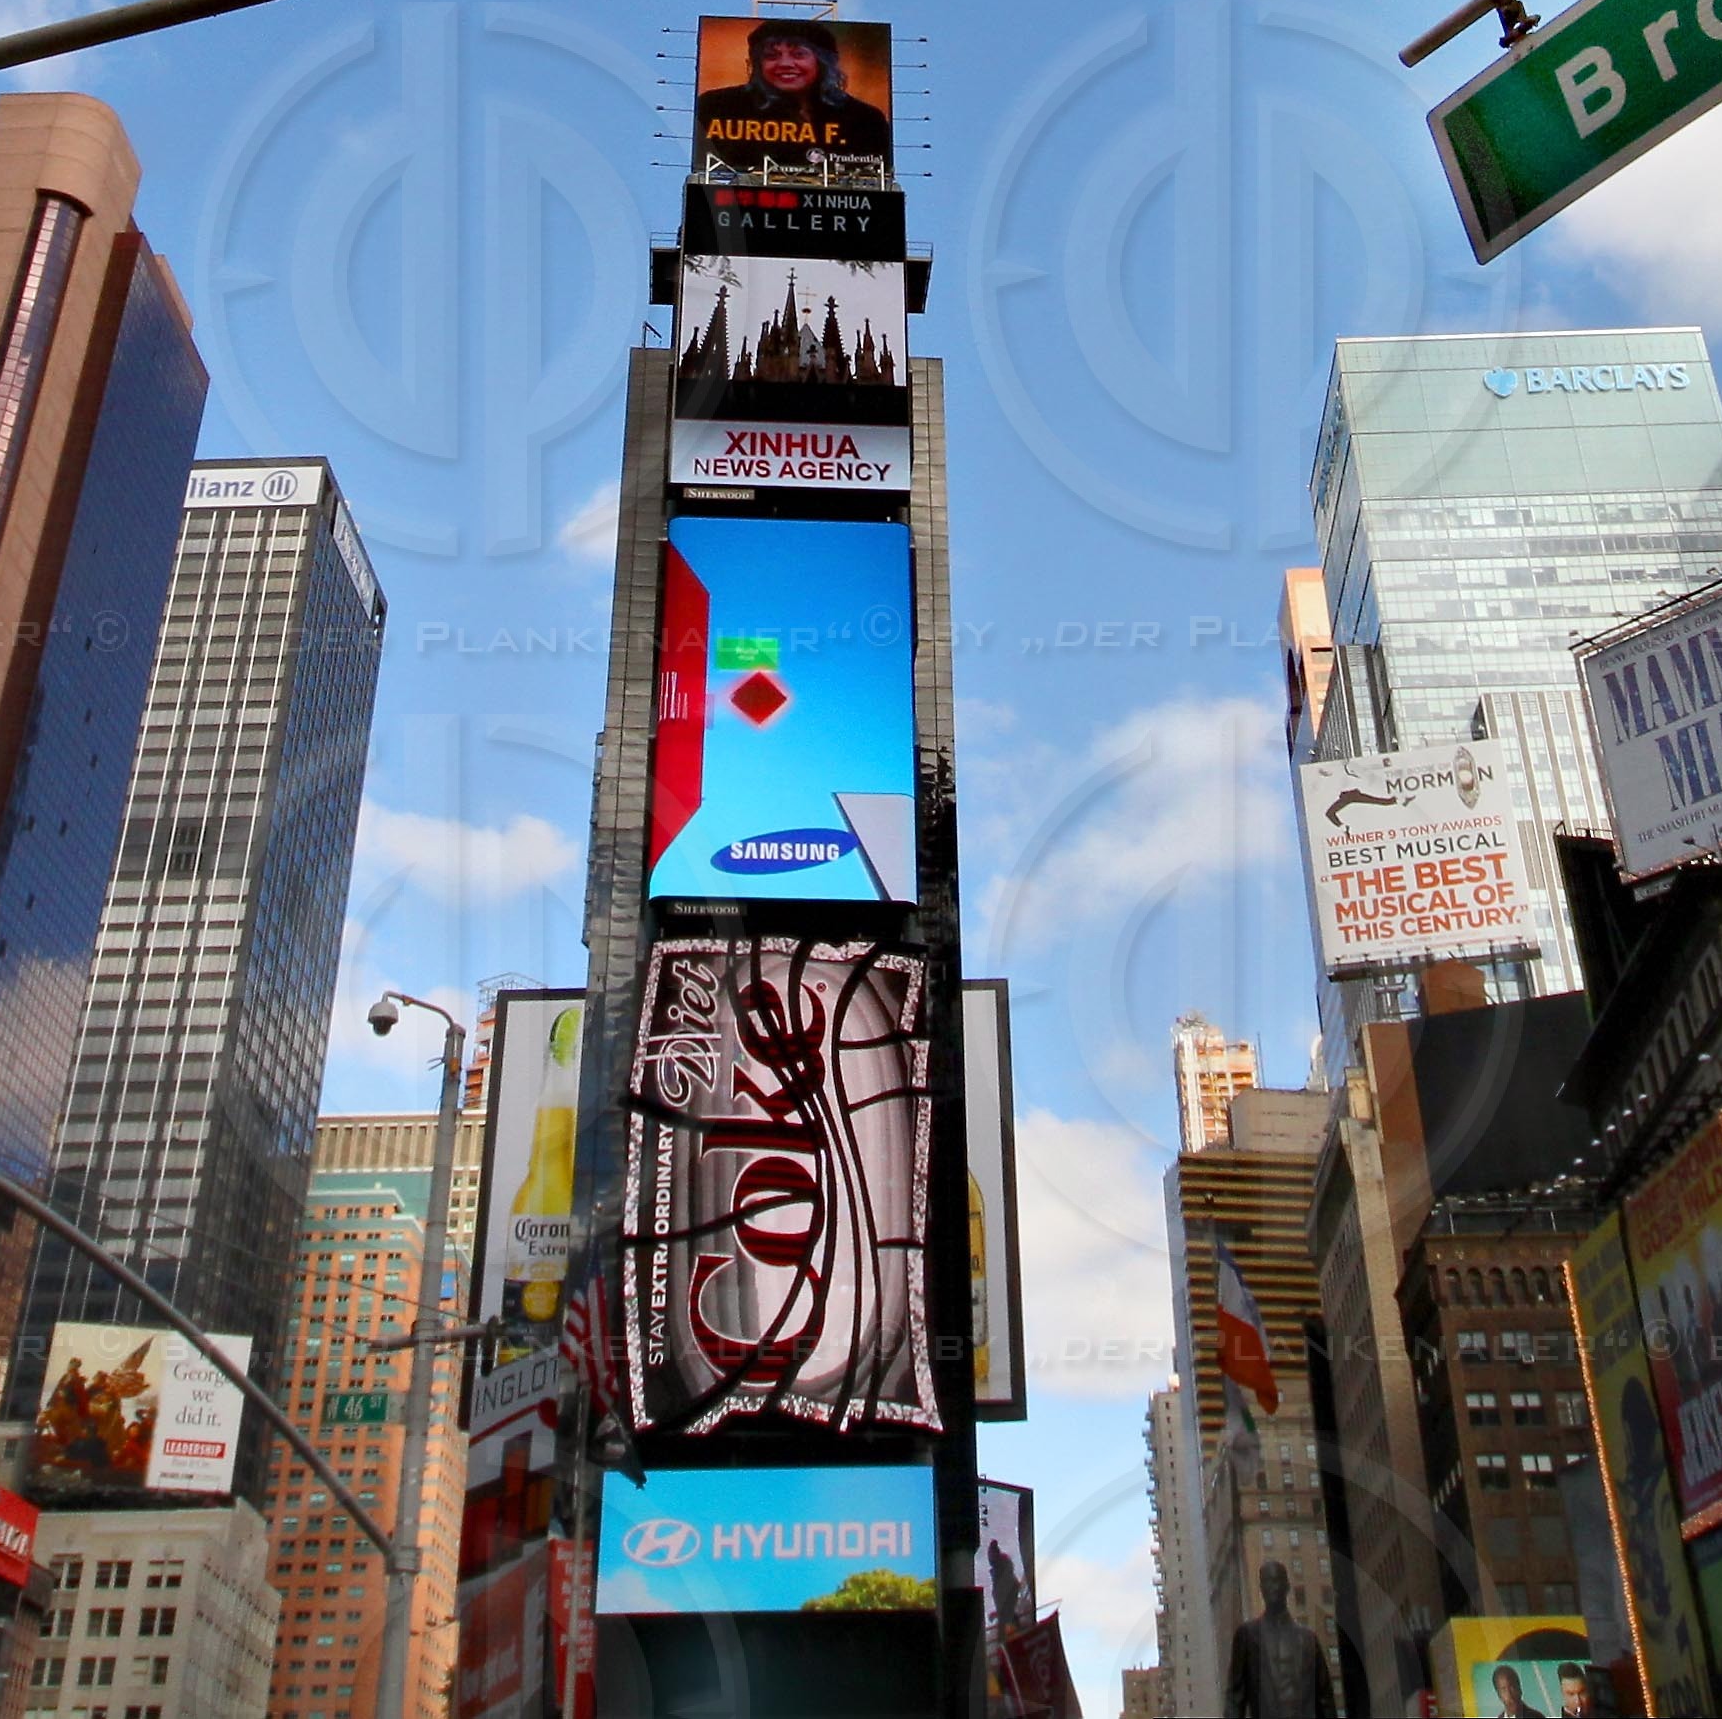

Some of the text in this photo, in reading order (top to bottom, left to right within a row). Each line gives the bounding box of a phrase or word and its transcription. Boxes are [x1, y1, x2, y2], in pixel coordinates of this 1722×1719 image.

[707, 119, 847, 144] AURORA F.
[803, 194, 872, 210] XINHUA
[718, 211, 870, 232] GALLERY
[1526, 363, 1690, 394] BARCLAYS
[725, 430, 861, 460] XINHUA
[693, 456, 891, 482] NEWS AGENCY
[188, 475, 256, 499] lianz
[1327, 815, 1502, 847] WINNER 9 TONY AWARDS
[731, 842, 840, 861] SAMSUNG
[1329, 831, 1506, 868] BEST MUSICAL
[1414, 852, 1507, 889] BEST
[1335, 882, 1514, 924] MUSICAL OF
[1338, 920, 1395, 944] THIS
[657, 960, 721, 1107] Diet
[690, 979, 826, 1386] Coke
[515, 1217, 570, 1241] Coron
[648, 1323, 664, 1365] STAY
[173, 1362, 233, 1385] Georg
[192, 1390, 214, 1403] we
[473, 1356, 560, 1417] INGLOT
[175, 1406, 221, 1427] did it.
[344, 1396, 363, 1420] 46
[369, 1395, 382, 1410] ST
[165, 1440, 223, 1457] LEADERSHIP
[712, 1521, 911, 1560] HYUNDAI
